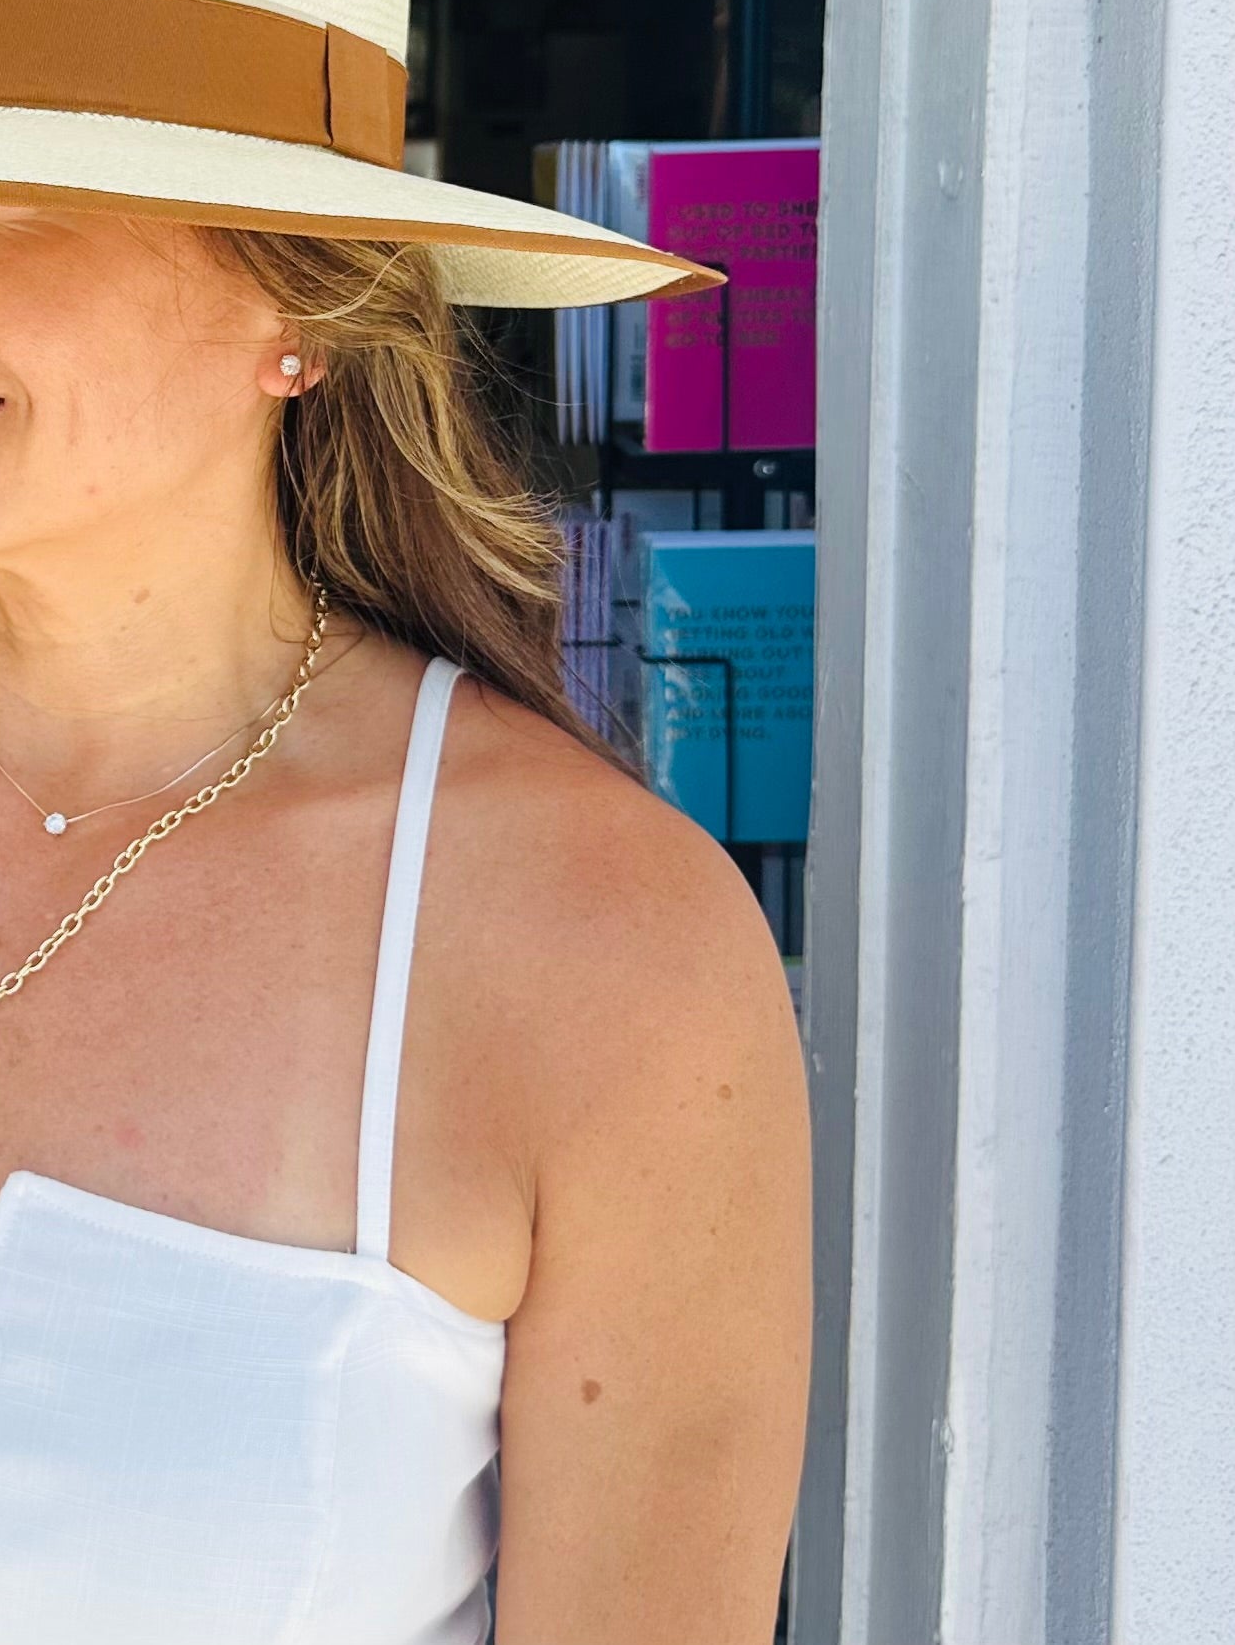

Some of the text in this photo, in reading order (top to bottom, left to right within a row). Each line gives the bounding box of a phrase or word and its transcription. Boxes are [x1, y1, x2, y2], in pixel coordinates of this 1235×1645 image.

[711, 605, 767, 621] KNOW
[755, 626, 794, 642] OLD
[762, 645, 804, 661] OUT
